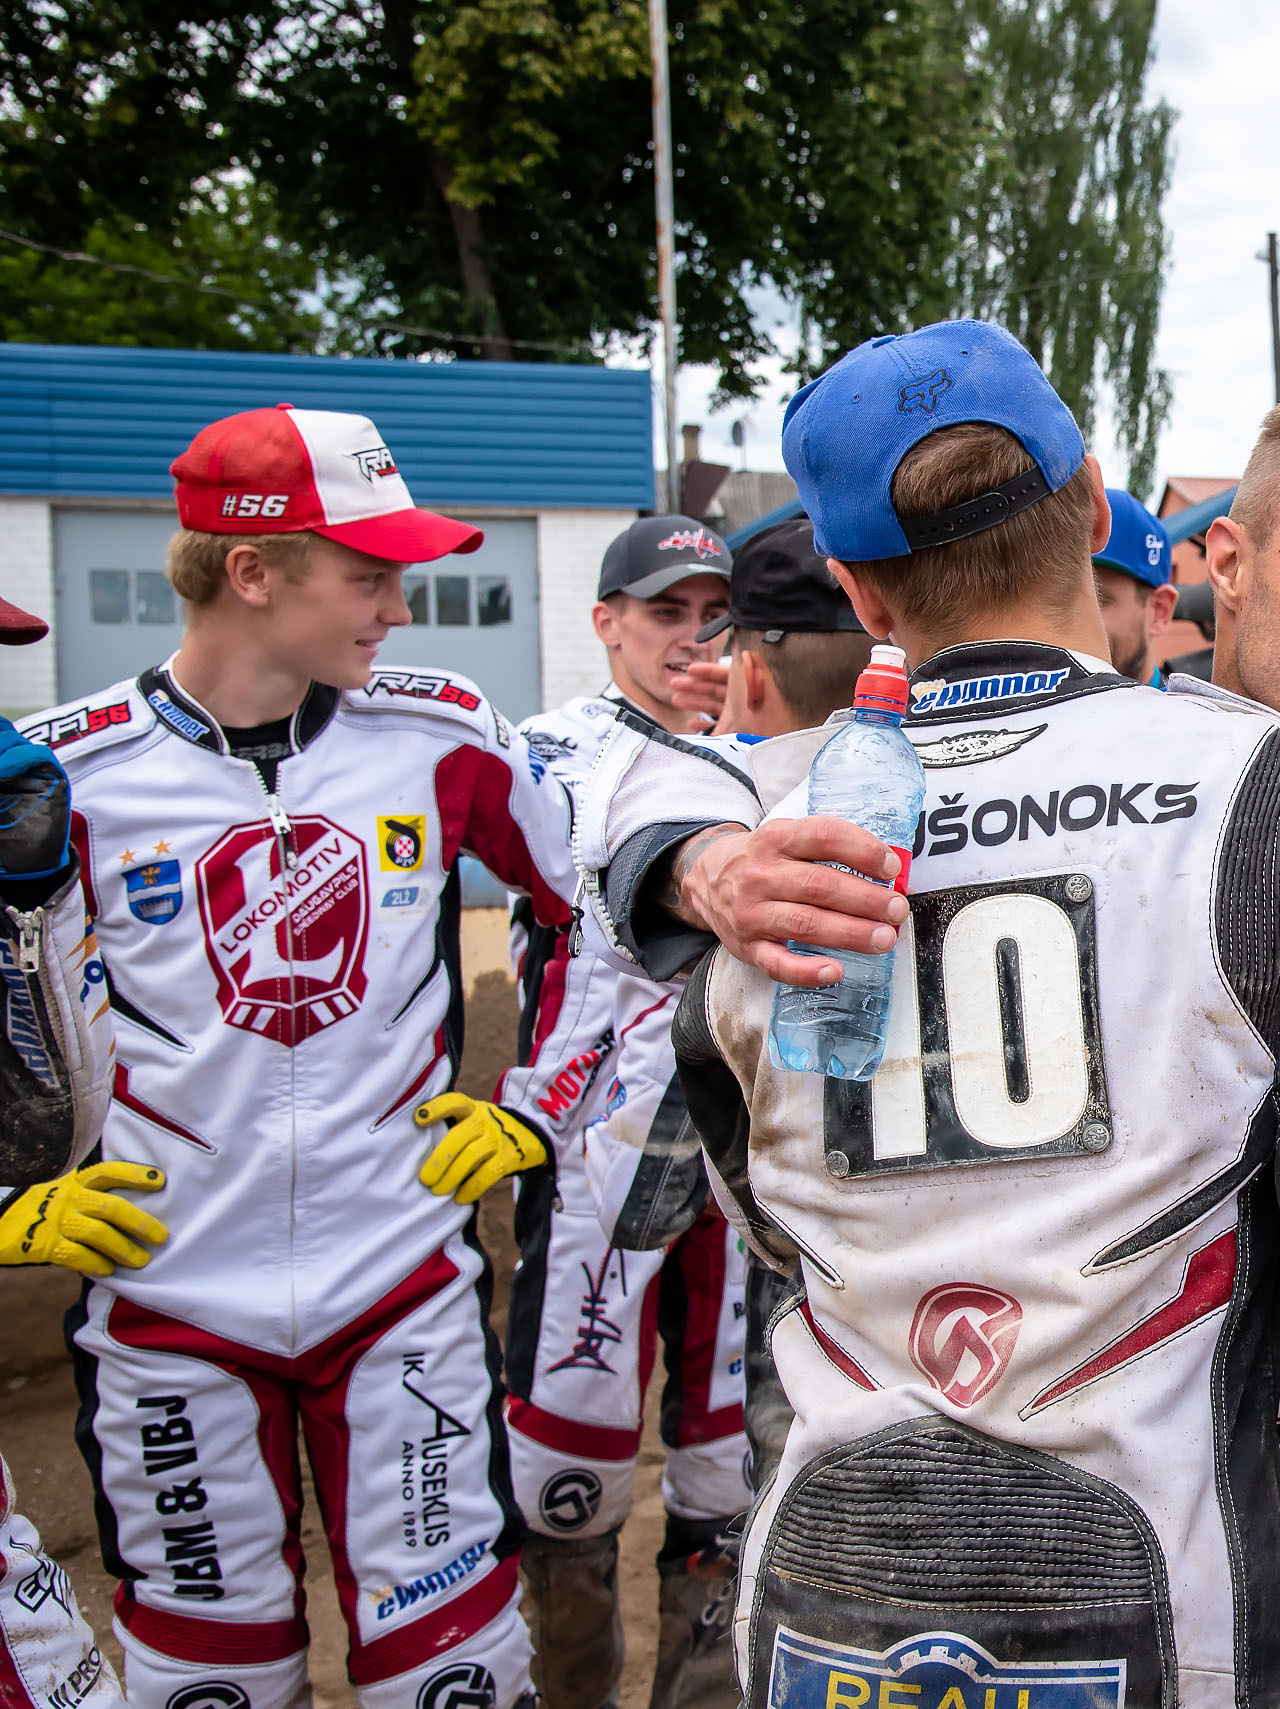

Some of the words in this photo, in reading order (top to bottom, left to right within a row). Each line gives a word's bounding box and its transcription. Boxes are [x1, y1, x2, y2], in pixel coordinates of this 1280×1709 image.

[223, 494, 289, 517] #56
[220, 837, 342, 954] LOKOMOTIV
[291, 864, 358, 925] DAUGAVPILS
[334, 878, 359, 900] CLUB
[872, 892, 1090, 1161] 10
[402, 1352, 425, 1375] IK
[402, 1441, 414, 1501] ANNO
[403, 1378, 471, 1547] AUSEKLIS
[155, 1477, 209, 1515] &
[403, 1511, 418, 1548] 1989
